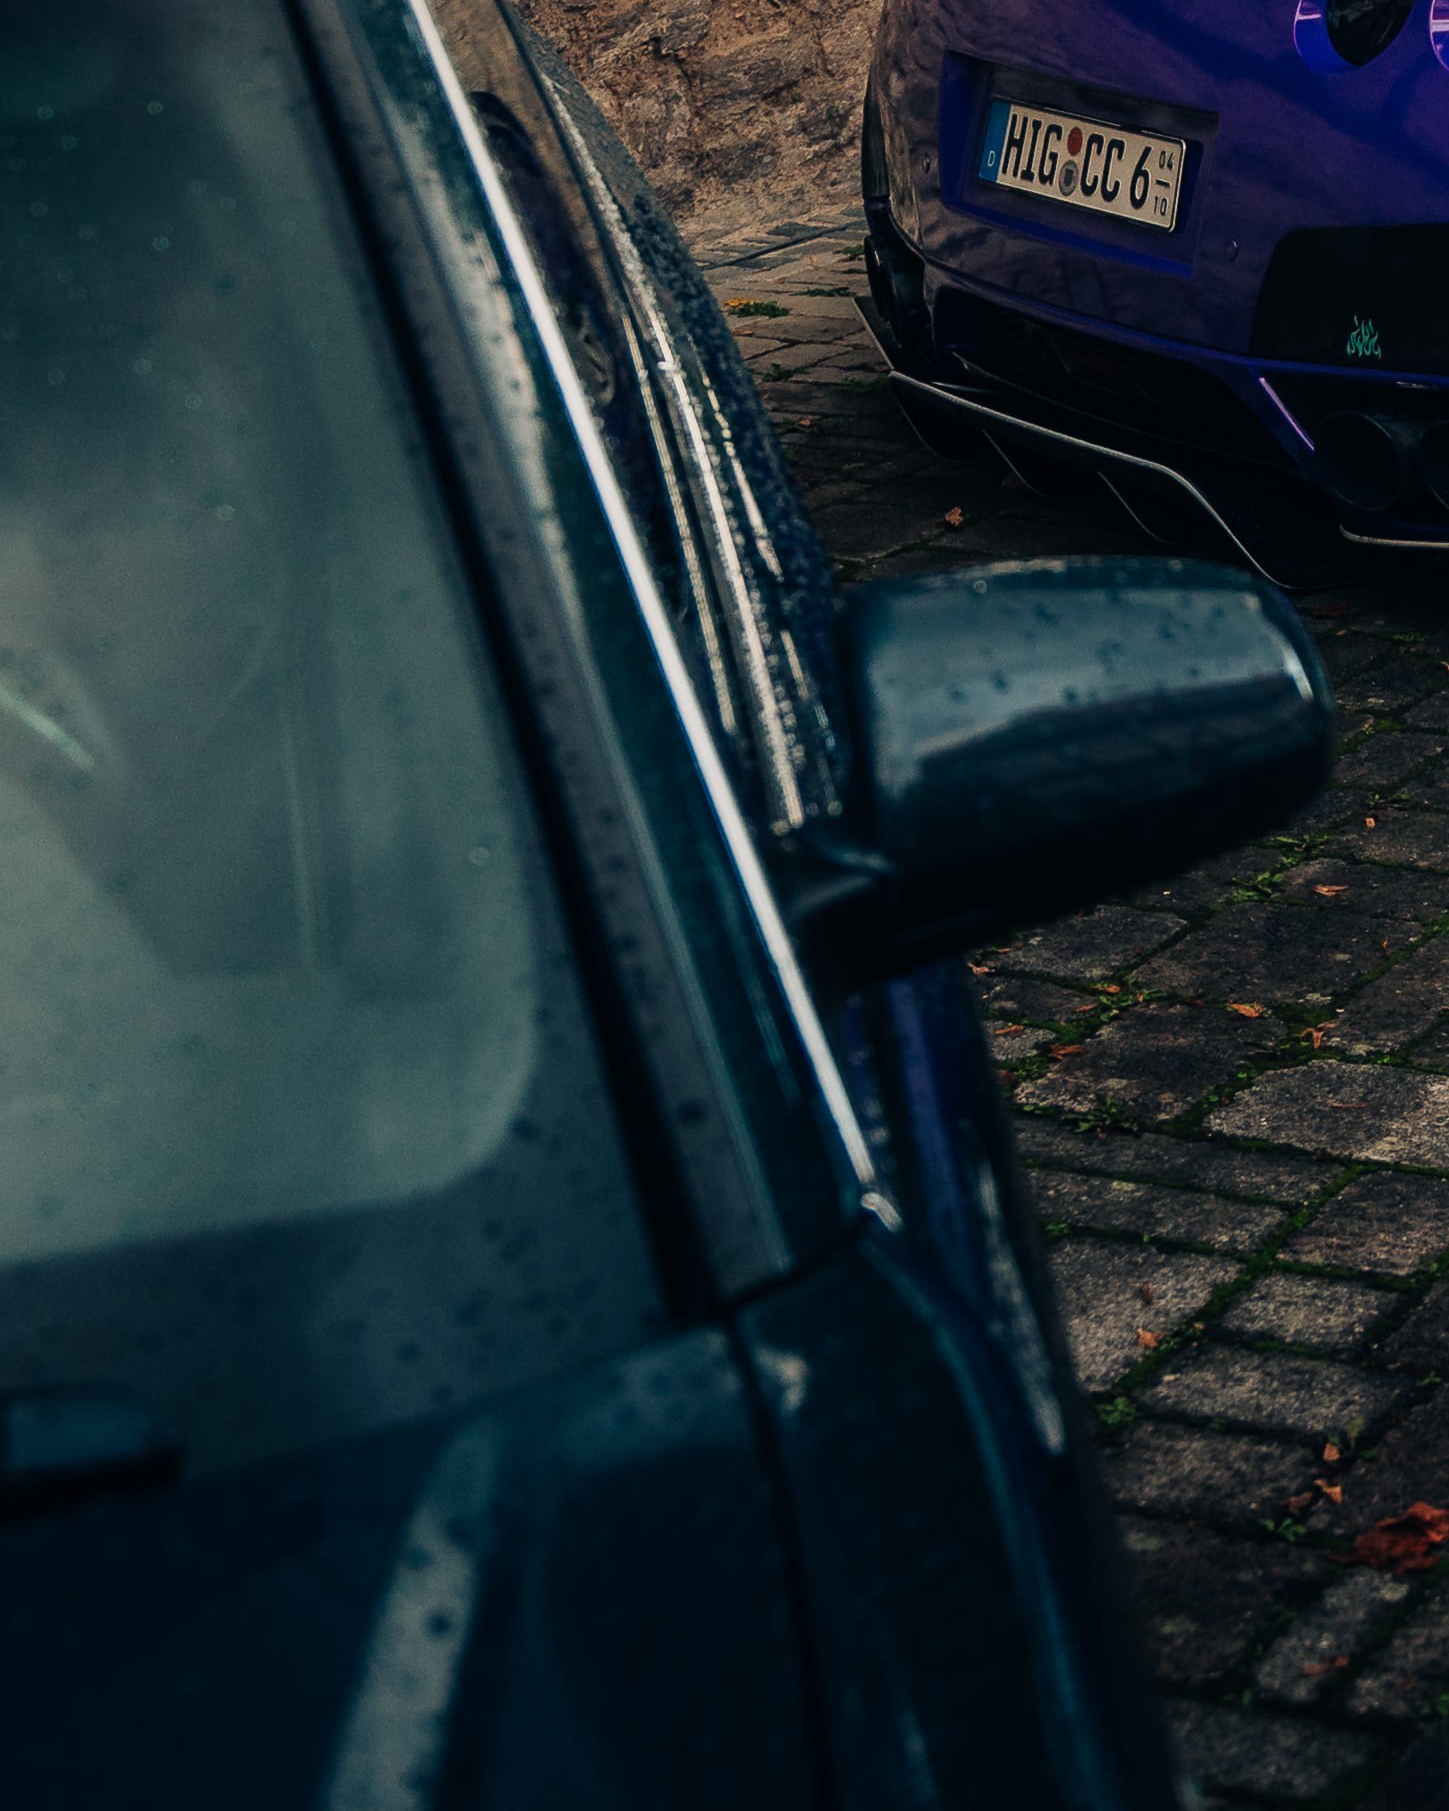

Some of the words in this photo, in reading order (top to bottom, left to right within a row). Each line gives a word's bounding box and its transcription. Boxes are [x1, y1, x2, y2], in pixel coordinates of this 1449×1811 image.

[987, 150, 996, 167] D
[1002, 114, 1063, 186] HIG
[1081, 133, 1125, 202] CC
[1129, 146, 1152, 209] 6
